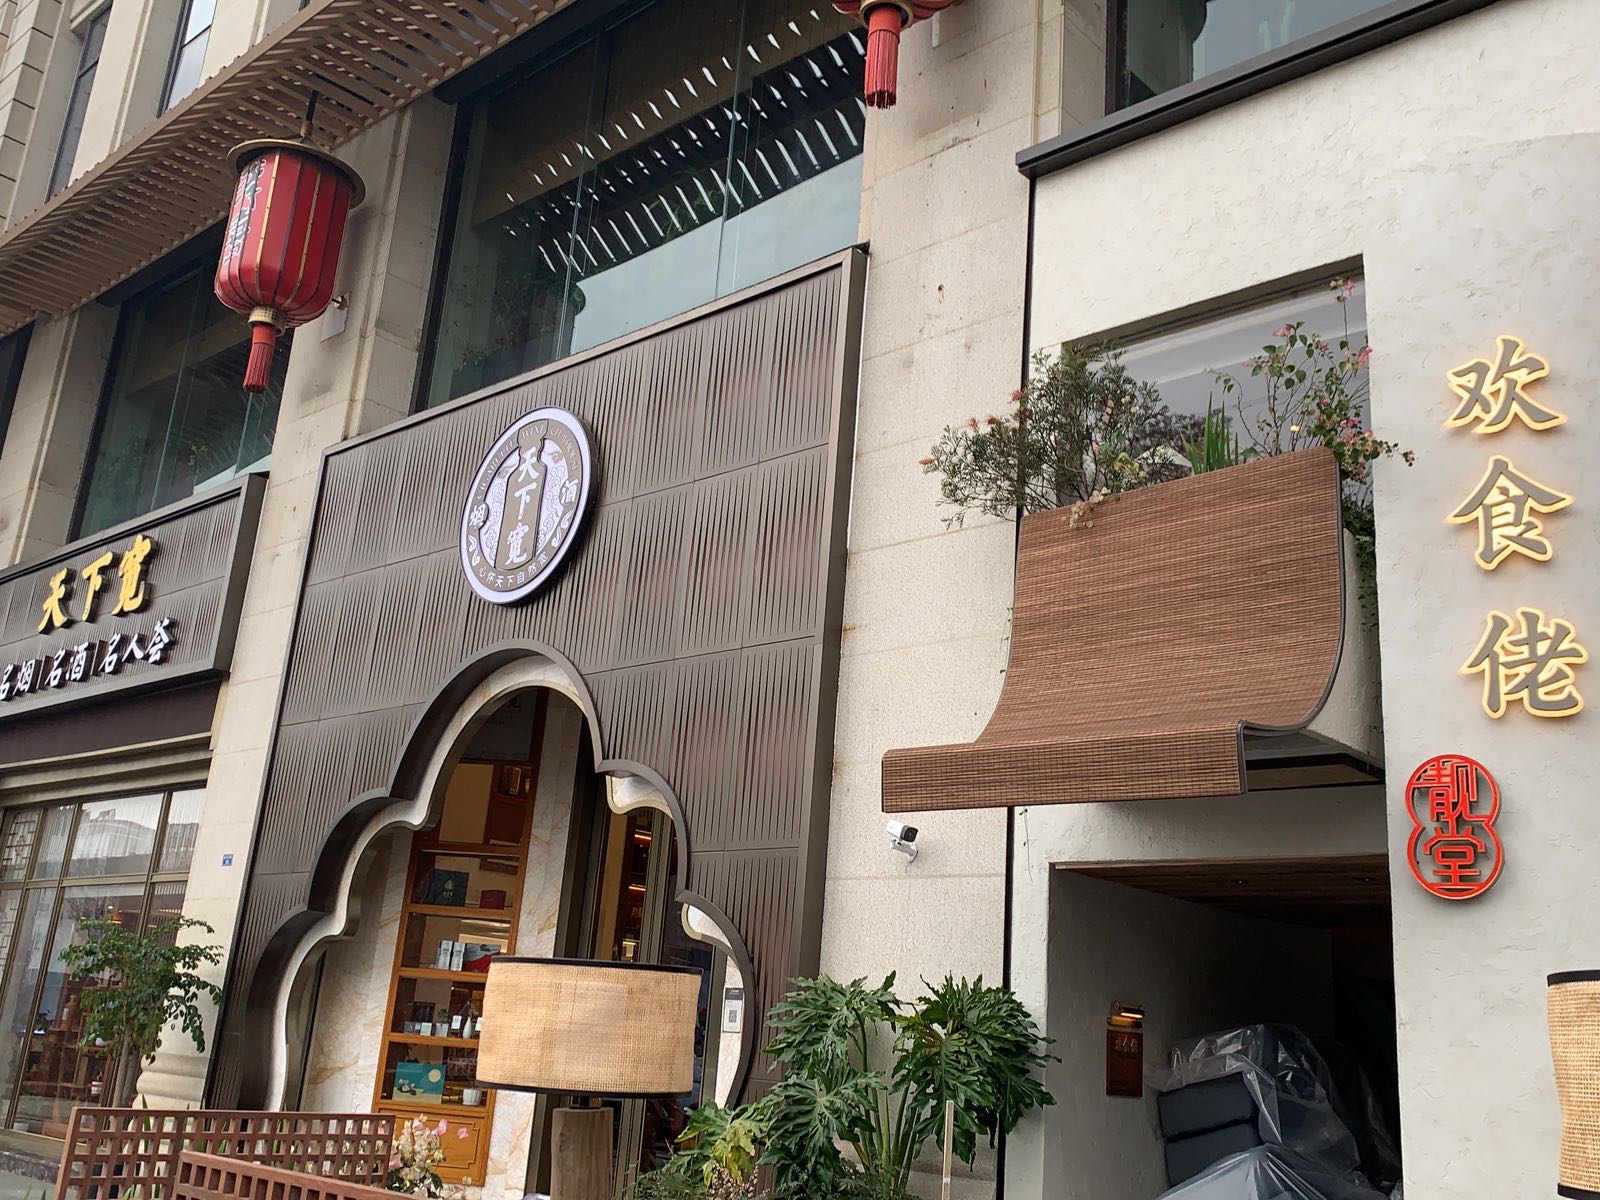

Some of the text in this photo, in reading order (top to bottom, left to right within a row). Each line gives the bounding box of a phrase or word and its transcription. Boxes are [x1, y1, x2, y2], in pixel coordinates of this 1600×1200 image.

[505, 447, 540, 565] 天下宽
[1443, 335, 1589, 719] 欢食佬
[37, 534, 152, 633] 天下宽
